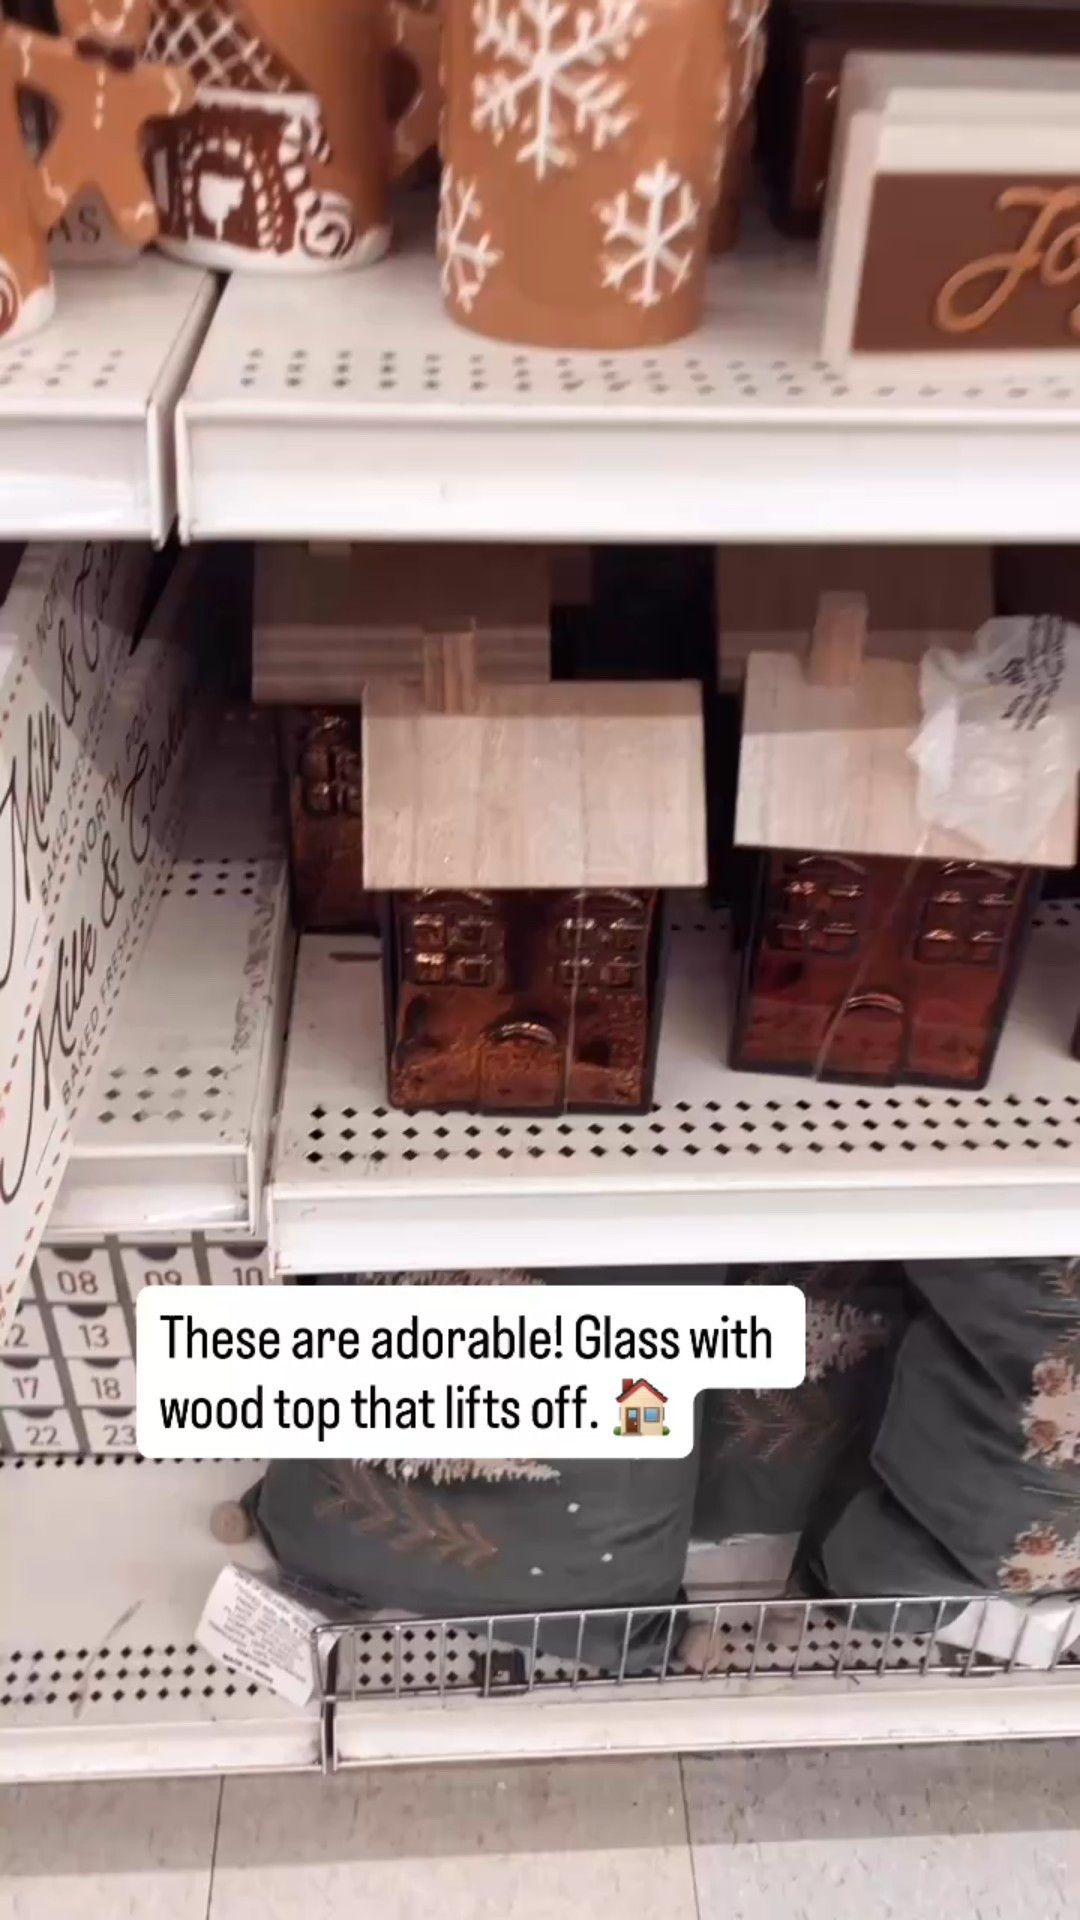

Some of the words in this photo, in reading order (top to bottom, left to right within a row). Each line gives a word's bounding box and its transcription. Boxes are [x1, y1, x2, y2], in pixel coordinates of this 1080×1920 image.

[935, 185, 1080, 333] Jo
[58, 617, 81, 727] &
[103, 831, 124, 929] &
[62, 1005, 98, 1105] BAKED
[57, 1270, 98, 1295] 08
[3, 1325, 29, 1348] 2
[78, 1324, 110, 1348] 13
[12, 1376, 39, 1400] 17
[91, 1376, 121, 1400] 18
[25, 1425, 61, 1447] 22
[103, 1424, 136, 1447] 23
